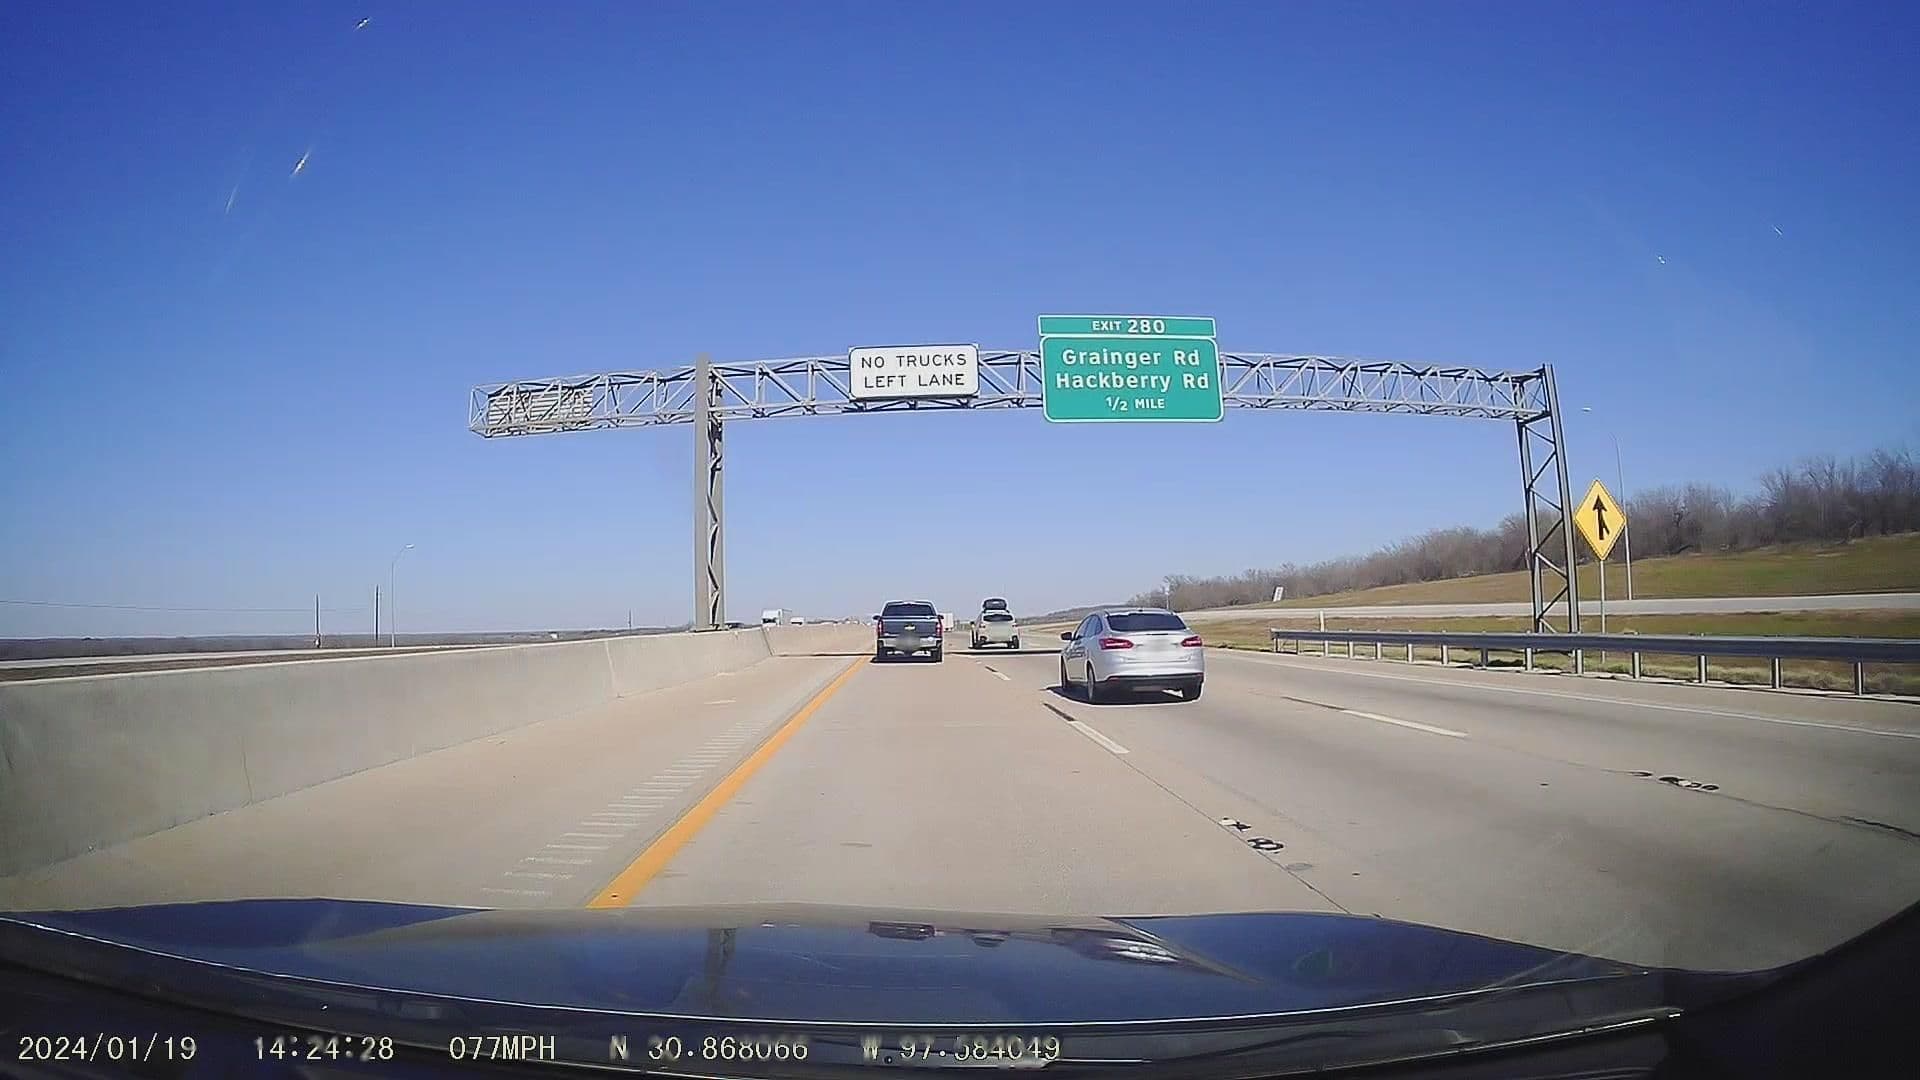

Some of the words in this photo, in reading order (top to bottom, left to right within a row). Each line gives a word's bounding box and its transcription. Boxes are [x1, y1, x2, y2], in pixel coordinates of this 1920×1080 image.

[1092, 320, 1122, 331] EXIT
[1127, 319, 1165, 334] 280
[861, 356, 885, 369] NO
[896, 353, 967, 367] TRUCKS
[1062, 348, 1161, 369] Grainger
[1173, 349, 1200, 366] Rd
[864, 375, 906, 389] LEFT
[918, 373, 965, 387] LANE
[1055, 371, 1170, 393] Hackberry
[1182, 372, 1209, 389] Rd
[1134, 398, 1165, 409] MILE
